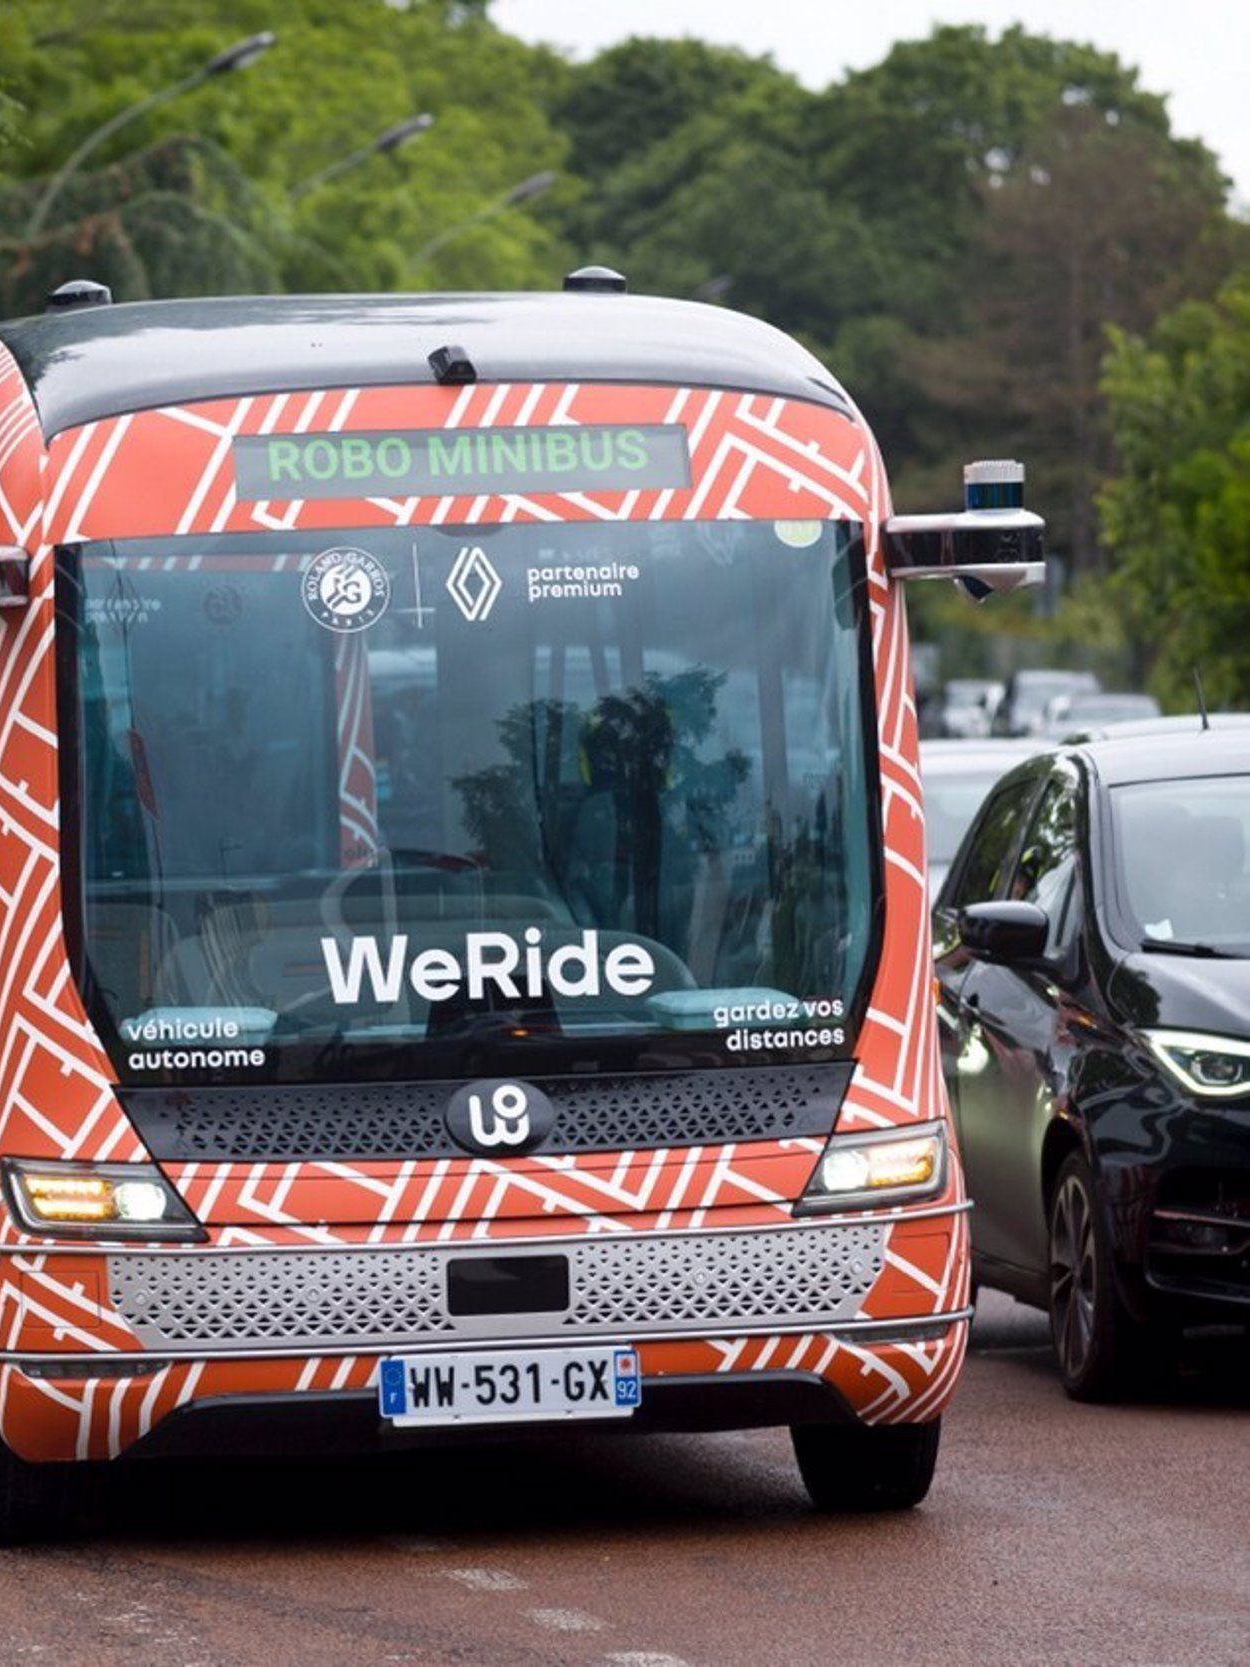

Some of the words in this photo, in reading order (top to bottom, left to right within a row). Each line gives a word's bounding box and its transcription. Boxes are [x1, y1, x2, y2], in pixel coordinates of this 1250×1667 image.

[268, 438, 412, 481] ROBO
[428, 429, 649, 477] MINIBUS
[306, 552, 342, 601] ROLAND
[343, 551, 385, 597] GARROS
[526, 561, 641, 583] partenaire
[527, 579, 623, 603] premium
[321, 928, 656, 1004] WeRide
[713, 999, 800, 1028] gardez
[802, 999, 844, 1018] vos
[127, 1016, 239, 1041] véhicule
[726, 1027, 846, 1051] distances
[128, 1049, 266, 1071] autonome
[390, 1392, 397, 1404] F
[409, 1359, 610, 1408] WW-531-GX
[617, 1381, 637, 1399] 92
